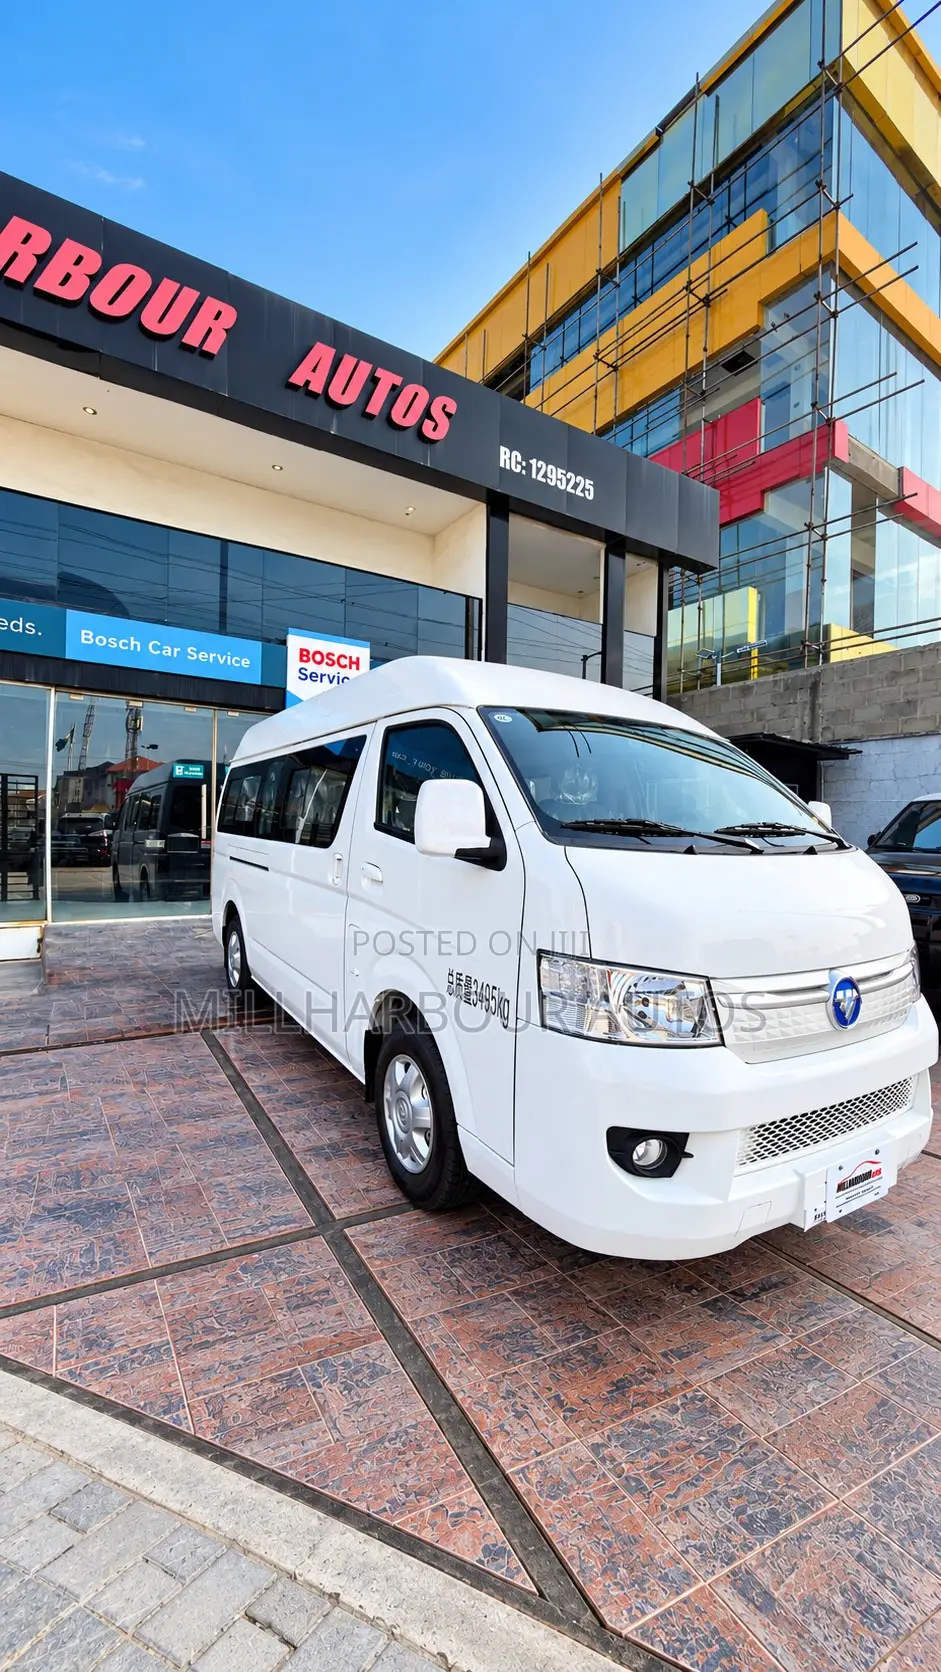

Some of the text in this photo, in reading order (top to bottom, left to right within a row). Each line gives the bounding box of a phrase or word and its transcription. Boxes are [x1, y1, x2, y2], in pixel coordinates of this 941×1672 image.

[288, 341, 457, 442] AUTOS
[500, 445, 594, 500] RC: 1295225
[80, 629, 251, 668] Bosch Car Service
[299, 648, 360, 671] BOSCH
[298, 667, 350, 685] Servic
